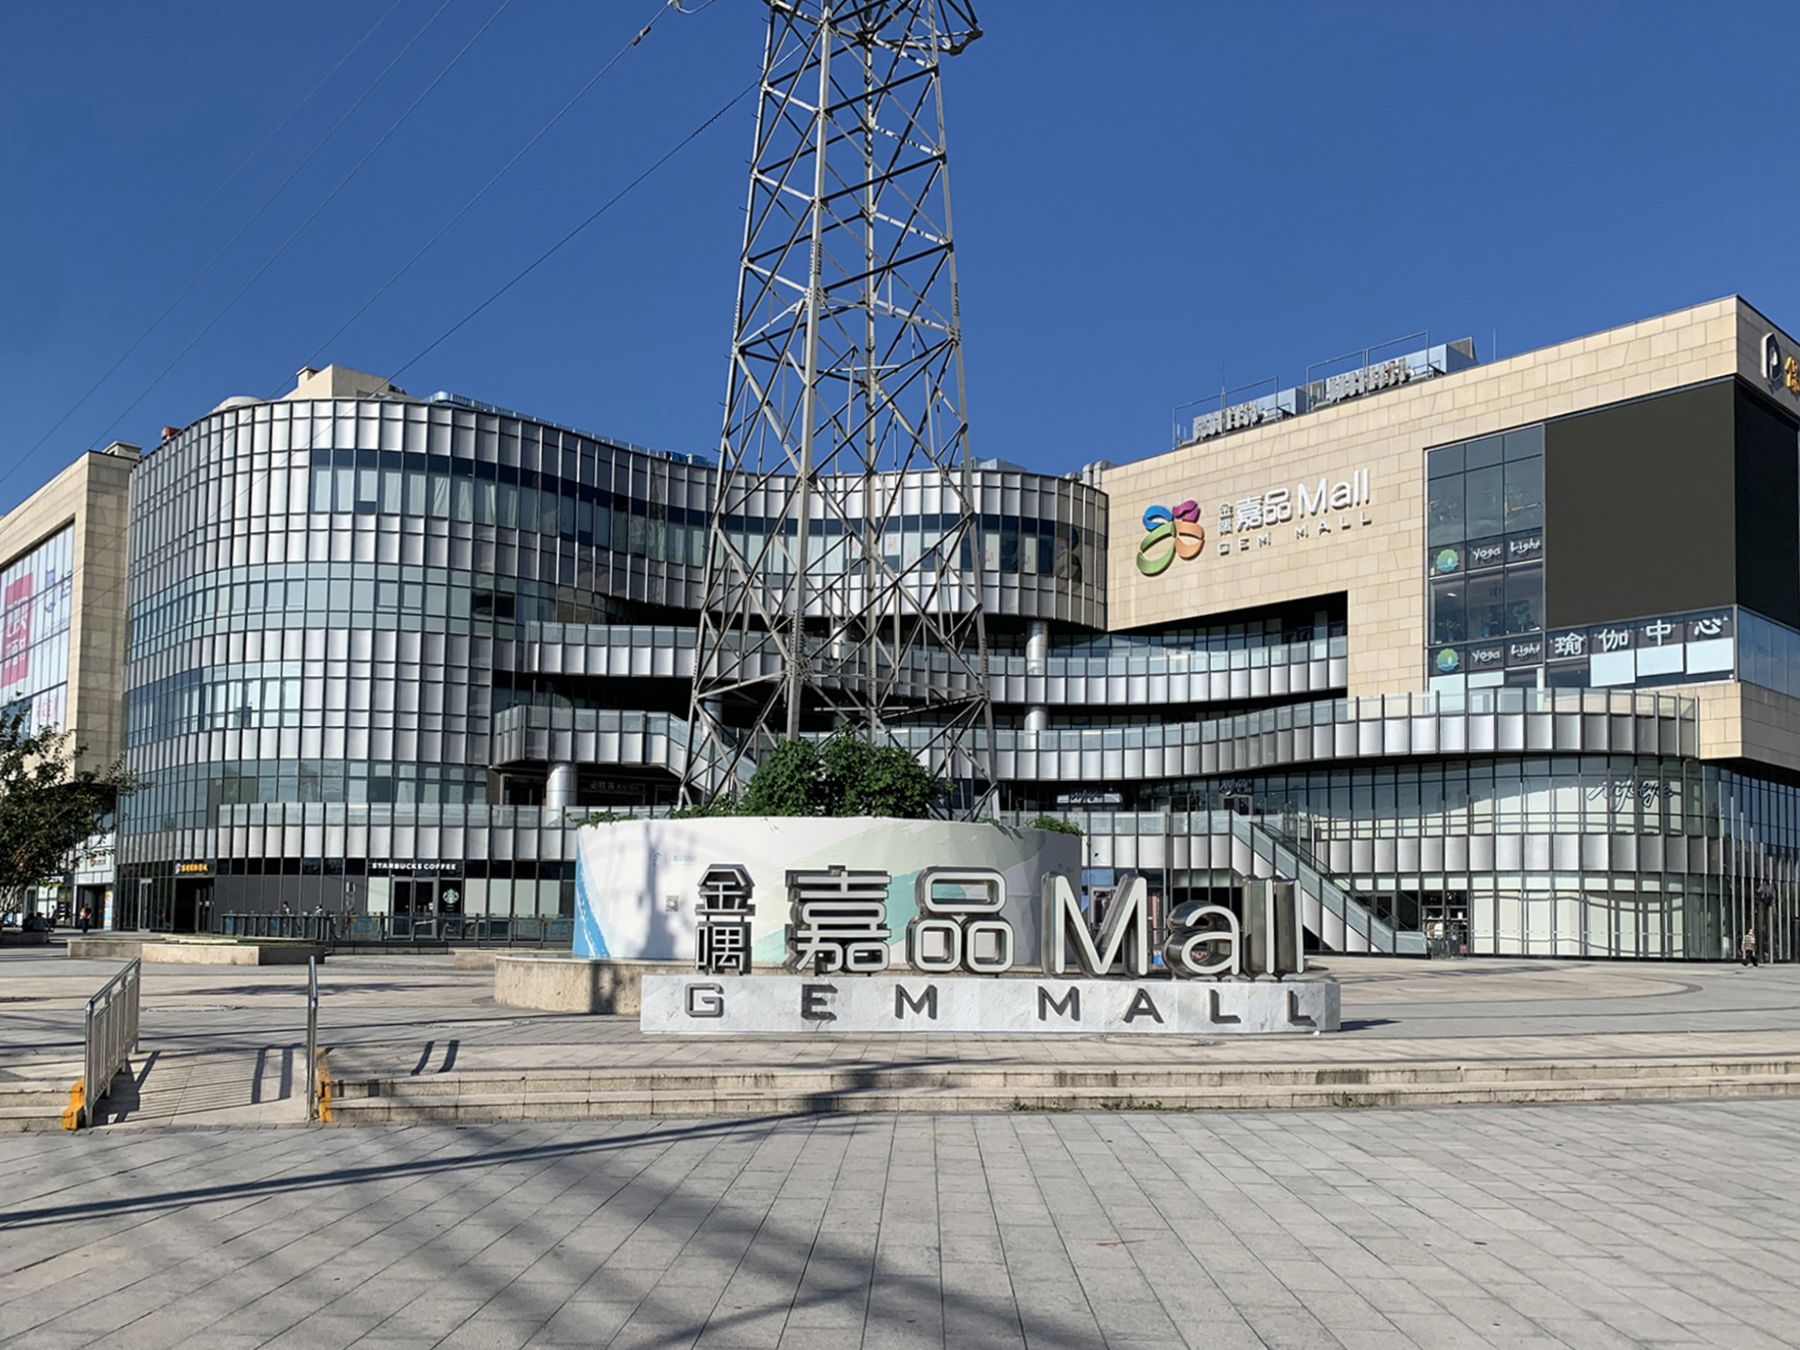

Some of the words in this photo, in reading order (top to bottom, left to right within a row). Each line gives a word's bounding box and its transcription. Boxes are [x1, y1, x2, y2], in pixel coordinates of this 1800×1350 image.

[1297, 467, 1370, 519] Mall
[1219, 532, 1272, 557] GEM
[1296, 511, 1372, 541] MALL
[1510, 538, 1541, 553] Light
[1510, 642, 1541, 657] Light
[1554, 616, 1722, 657] 瑜伽中心
[371, 862, 423, 870] STARBUCKS
[423, 863, 457, 871] COFFEE
[695, 863, 756, 975] 金隅
[1041, 872, 1305, 979] Mall
[684, 983, 938, 1021] GEM
[1037, 986, 1317, 1028] MALL
